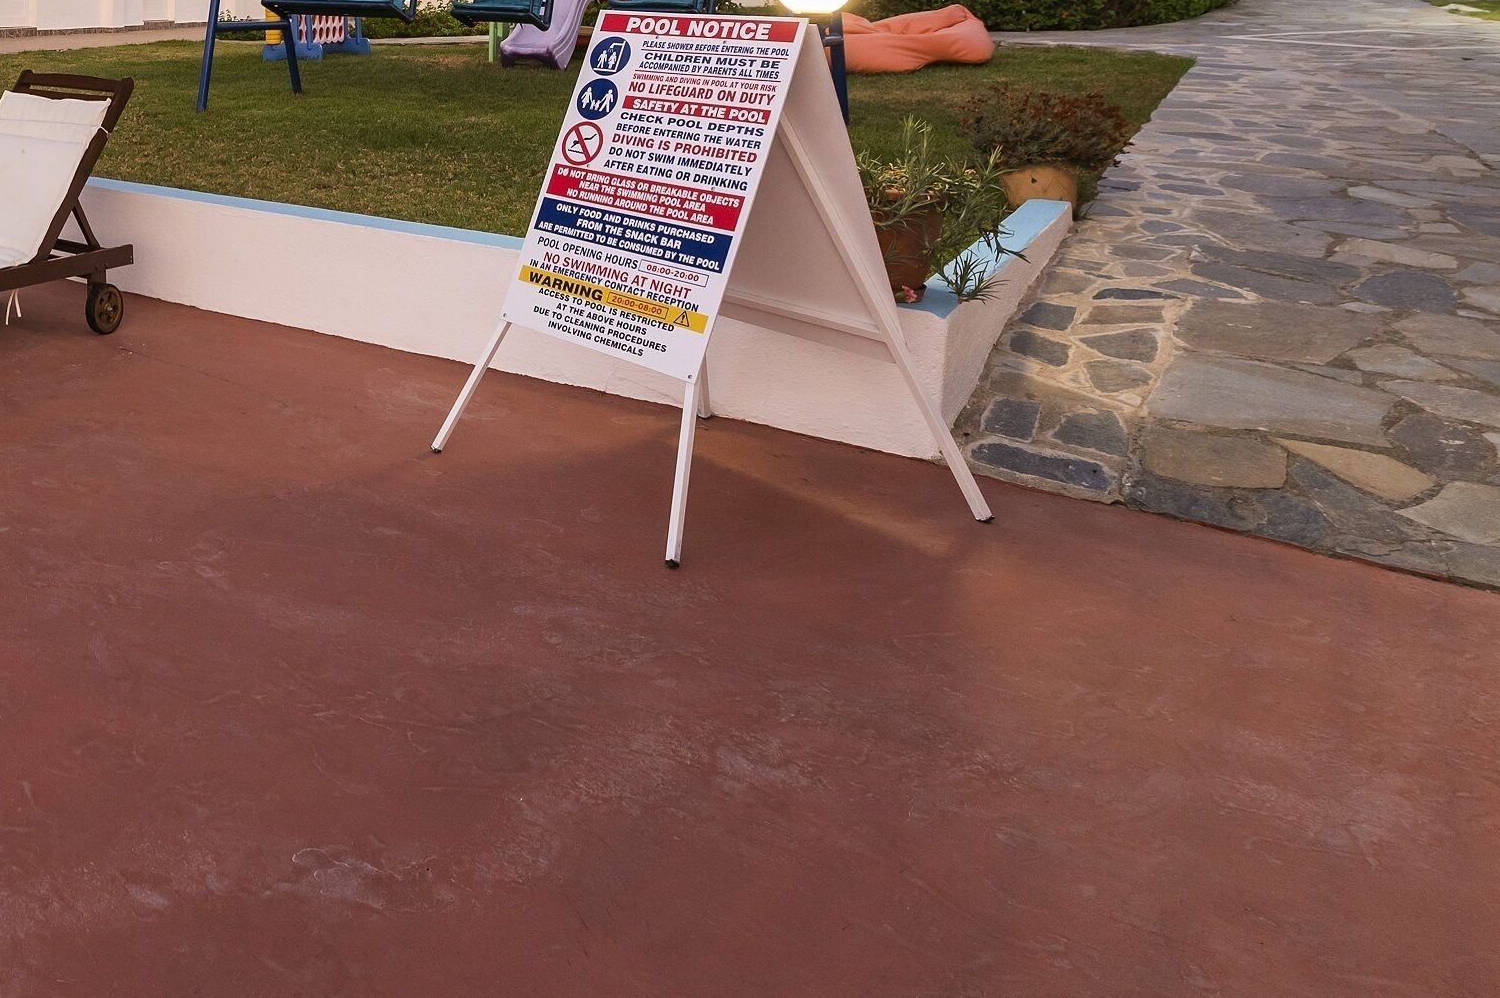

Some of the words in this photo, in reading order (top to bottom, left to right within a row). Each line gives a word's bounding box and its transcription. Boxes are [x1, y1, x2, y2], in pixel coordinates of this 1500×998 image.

[625, 17, 684, 35] POOL
[686, 20, 772, 40] NOTICE
[642, 40, 666, 48] PLEASE
[666, 41, 694, 50] SHOWER
[694, 43, 721, 52] BEFORE
[720, 45, 755, 54] ENTERING
[754, 47, 770, 55] THE
[769, 48, 790, 57] POOL
[643, 52, 712, 64] CHILDREN
[714, 57, 756, 68] MUST
[759, 60, 780, 70] BE
[632, 72, 664, 81] SWIMMING
[664, 75, 679, 83] AND
[678, 76, 701, 85] DIVING
[701, 78, 709, 86] IN
[709, 79, 729, 88] POOL
[738, 82, 757, 90] YOUR
[757, 84, 777, 92] RISK
[638, 60, 690, 72] ACCOMPANIED
[690, 65, 702, 73] BY
[702, 66, 737, 76] PARENTS
[737, 69, 753, 77] ALL
[754, 70, 779, 79] TIMES
[628, 81, 646, 92] NO
[647, 83, 713, 100] LIFEGUARD
[716, 90, 738, 102] ON
[738, 92, 774, 106] DUTY
[619, 111, 664, 124] CHECK
[666, 117, 704, 129] POOL
[706, 122, 764, 137] DEPTHS
[632, 98, 679, 112] SAFETY
[679, 103, 696, 114] AT
[704, 106, 726, 118] THE
[728, 109, 767, 123] POOL
[611, 133, 656, 148] DIVING
[657, 140, 671, 150] IS
[673, 142, 757, 163] PROHIBITED
[615, 122, 652, 134] BEFORE
[652, 127, 701, 141] ENTERING
[702, 134, 723, 144] THE
[724, 137, 761, 150] WATER
[603, 158, 634, 172] AFTER
[635, 164, 673, 178] EATING
[674, 170, 691, 182] OR
[692, 173, 748, 191] DRINKING
[608, 146, 623, 156] DO
[624, 148, 646, 160] NOT
[646, 152, 675, 164] SWIM
[676, 156, 752, 177] IMMEDIATELY
[557, 167, 568, 176] DO
[569, 169, 585, 179] NOT
[586, 172, 610, 184] BRING
[610, 177, 636, 188] GLASS
[637, 182, 650, 191] OR
[650, 184, 698, 200] BREAKABLE
[699, 193, 740, 208] OBJECTS
[578, 180, 599, 191] NEAR
[599, 184, 615, 194] THE
[616, 188, 658, 202] SWIMMING
[659, 196, 682, 207] POOL
[682, 200, 706, 212] AREA
[566, 188, 578, 197] NO
[578, 190, 614, 204] RUNNING
[614, 197, 648, 211] AROUND
[648, 204, 665, 215] THE
[666, 207, 689, 220] POOL
[690, 212, 714, 224] AREA
[555, 203, 578, 214] ONLY
[578, 208, 602, 219] FOOD
[602, 213, 620, 223] AND
[621, 217, 654, 231] DRINKS
[654, 224, 715, 244] PURCHASED
[575, 218, 603, 231] FROM
[604, 225, 624, 236] THE
[624, 229, 659, 244] SNACK
[659, 237, 681, 249] BAR
[537, 236, 561, 250] POOL
[561, 242, 603, 260] OPENING
[603, 252, 639, 269] HOURS
[644, 262, 700, 284] 08:00-20:00
[538, 221, 553, 231] ARE
[553, 225, 594, 240] PERMITTED
[594, 234, 606, 243] TO
[606, 237, 618, 246] BE
[618, 240, 663, 256] CONSUMED
[664, 250, 676, 260] BY
[676, 253, 695, 264] THE
[695, 258, 720, 270] POOL
[529, 259, 538, 268] IN
[539, 262, 551, 271] AN
[552, 265, 602, 285] EMERGENCY
[603, 279, 645, 297] CONTACT
[646, 290, 699, 311] RECEPTION
[543, 251, 560, 264] NO
[561, 256, 629, 282] SWIMMING
[630, 274, 647, 287] AT
[649, 278, 691, 299] NIGHT
[527, 271, 604, 301] WARNING
[610, 294, 663, 318] 20:00-08:00
[538, 287, 570, 302] ACCESS
[570, 296, 583, 305] TO
[584, 300, 607, 312] POOL
[608, 307, 617, 315] IS
[618, 310, 674, 332] RESTRICTED
[533, 306, 550, 316] DUE
[550, 311, 562, 320] TO
[563, 315, 606, 333] CLEANING
[606, 328, 667, 352] PROCEDURES
[555, 302, 566, 311] AT
[567, 306, 585, 316] THE
[585, 311, 615, 325] ABOVE
[615, 320, 647, 335] HOURS
[547, 320, 592, 340] INVOLVING
[593, 334, 644, 356] CHEMICALS
